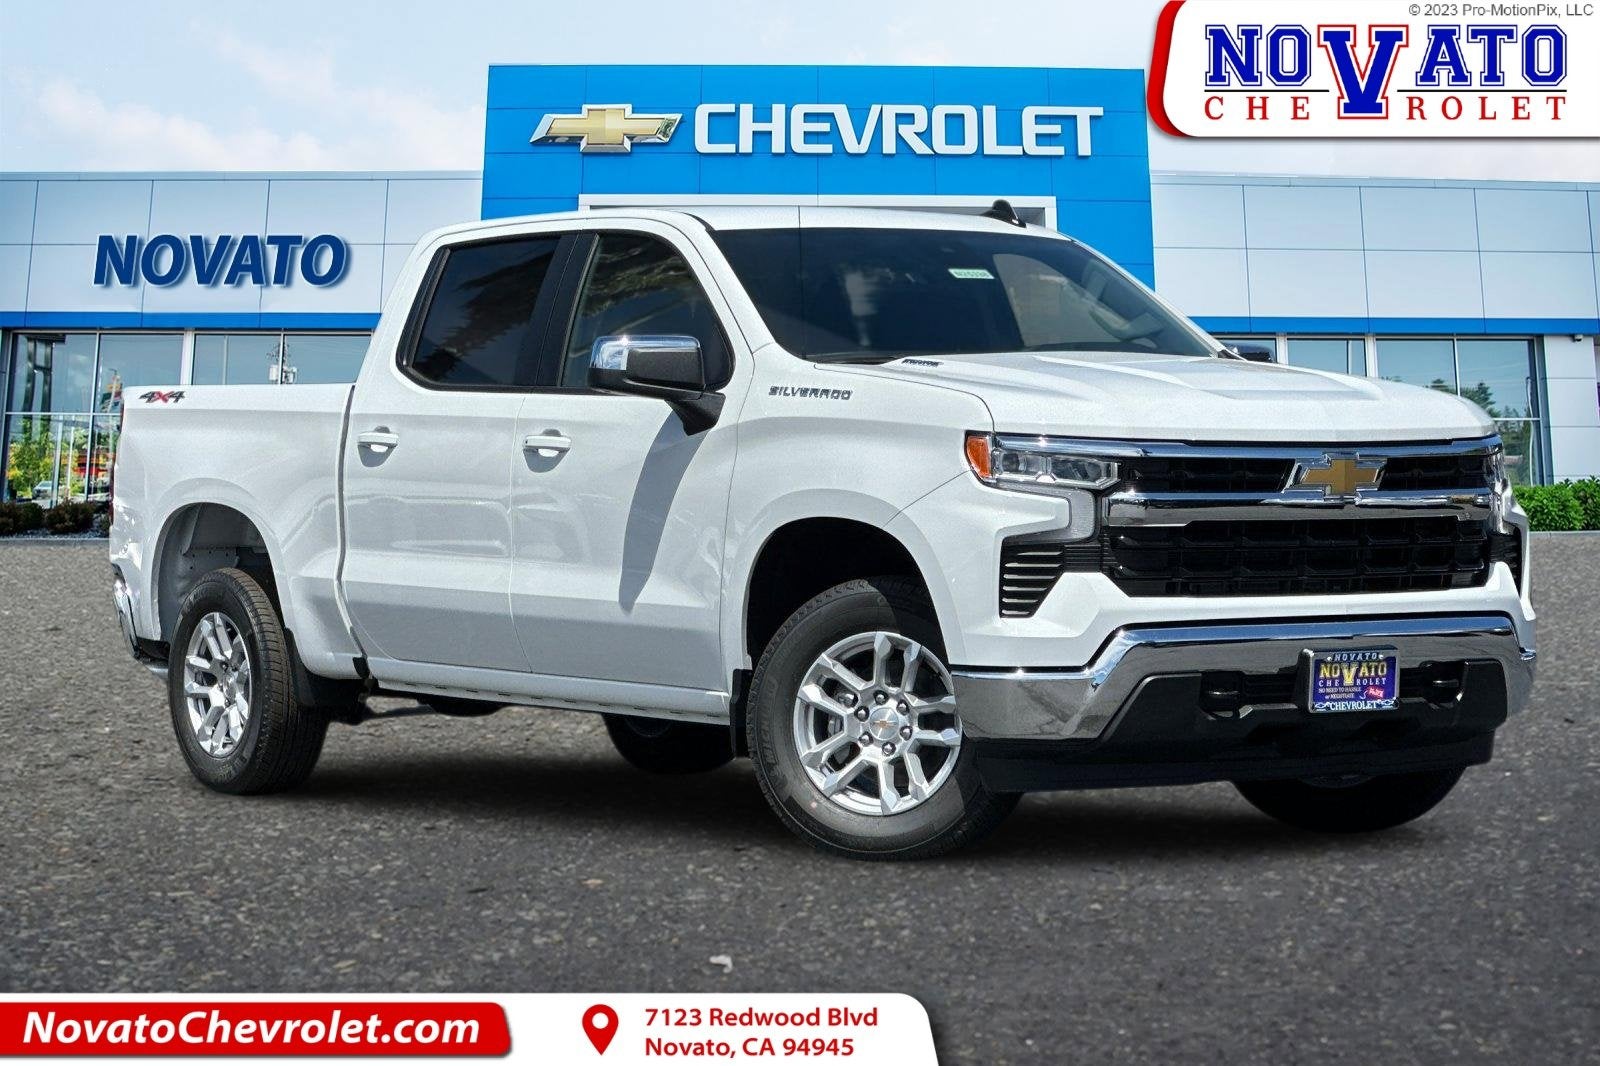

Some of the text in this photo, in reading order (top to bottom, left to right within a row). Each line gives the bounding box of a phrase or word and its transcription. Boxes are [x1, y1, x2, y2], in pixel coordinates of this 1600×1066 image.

[694, 103, 1104, 157] CHEVROLET
[93, 234, 348, 286] NOVATO
[768, 386, 853, 400] SILVERADO
[1334, 652, 1377, 661] NOVATO
[1319, 662, 1387, 686] NOVATO
[1330, 700, 1377, 710] CHEVROLET
